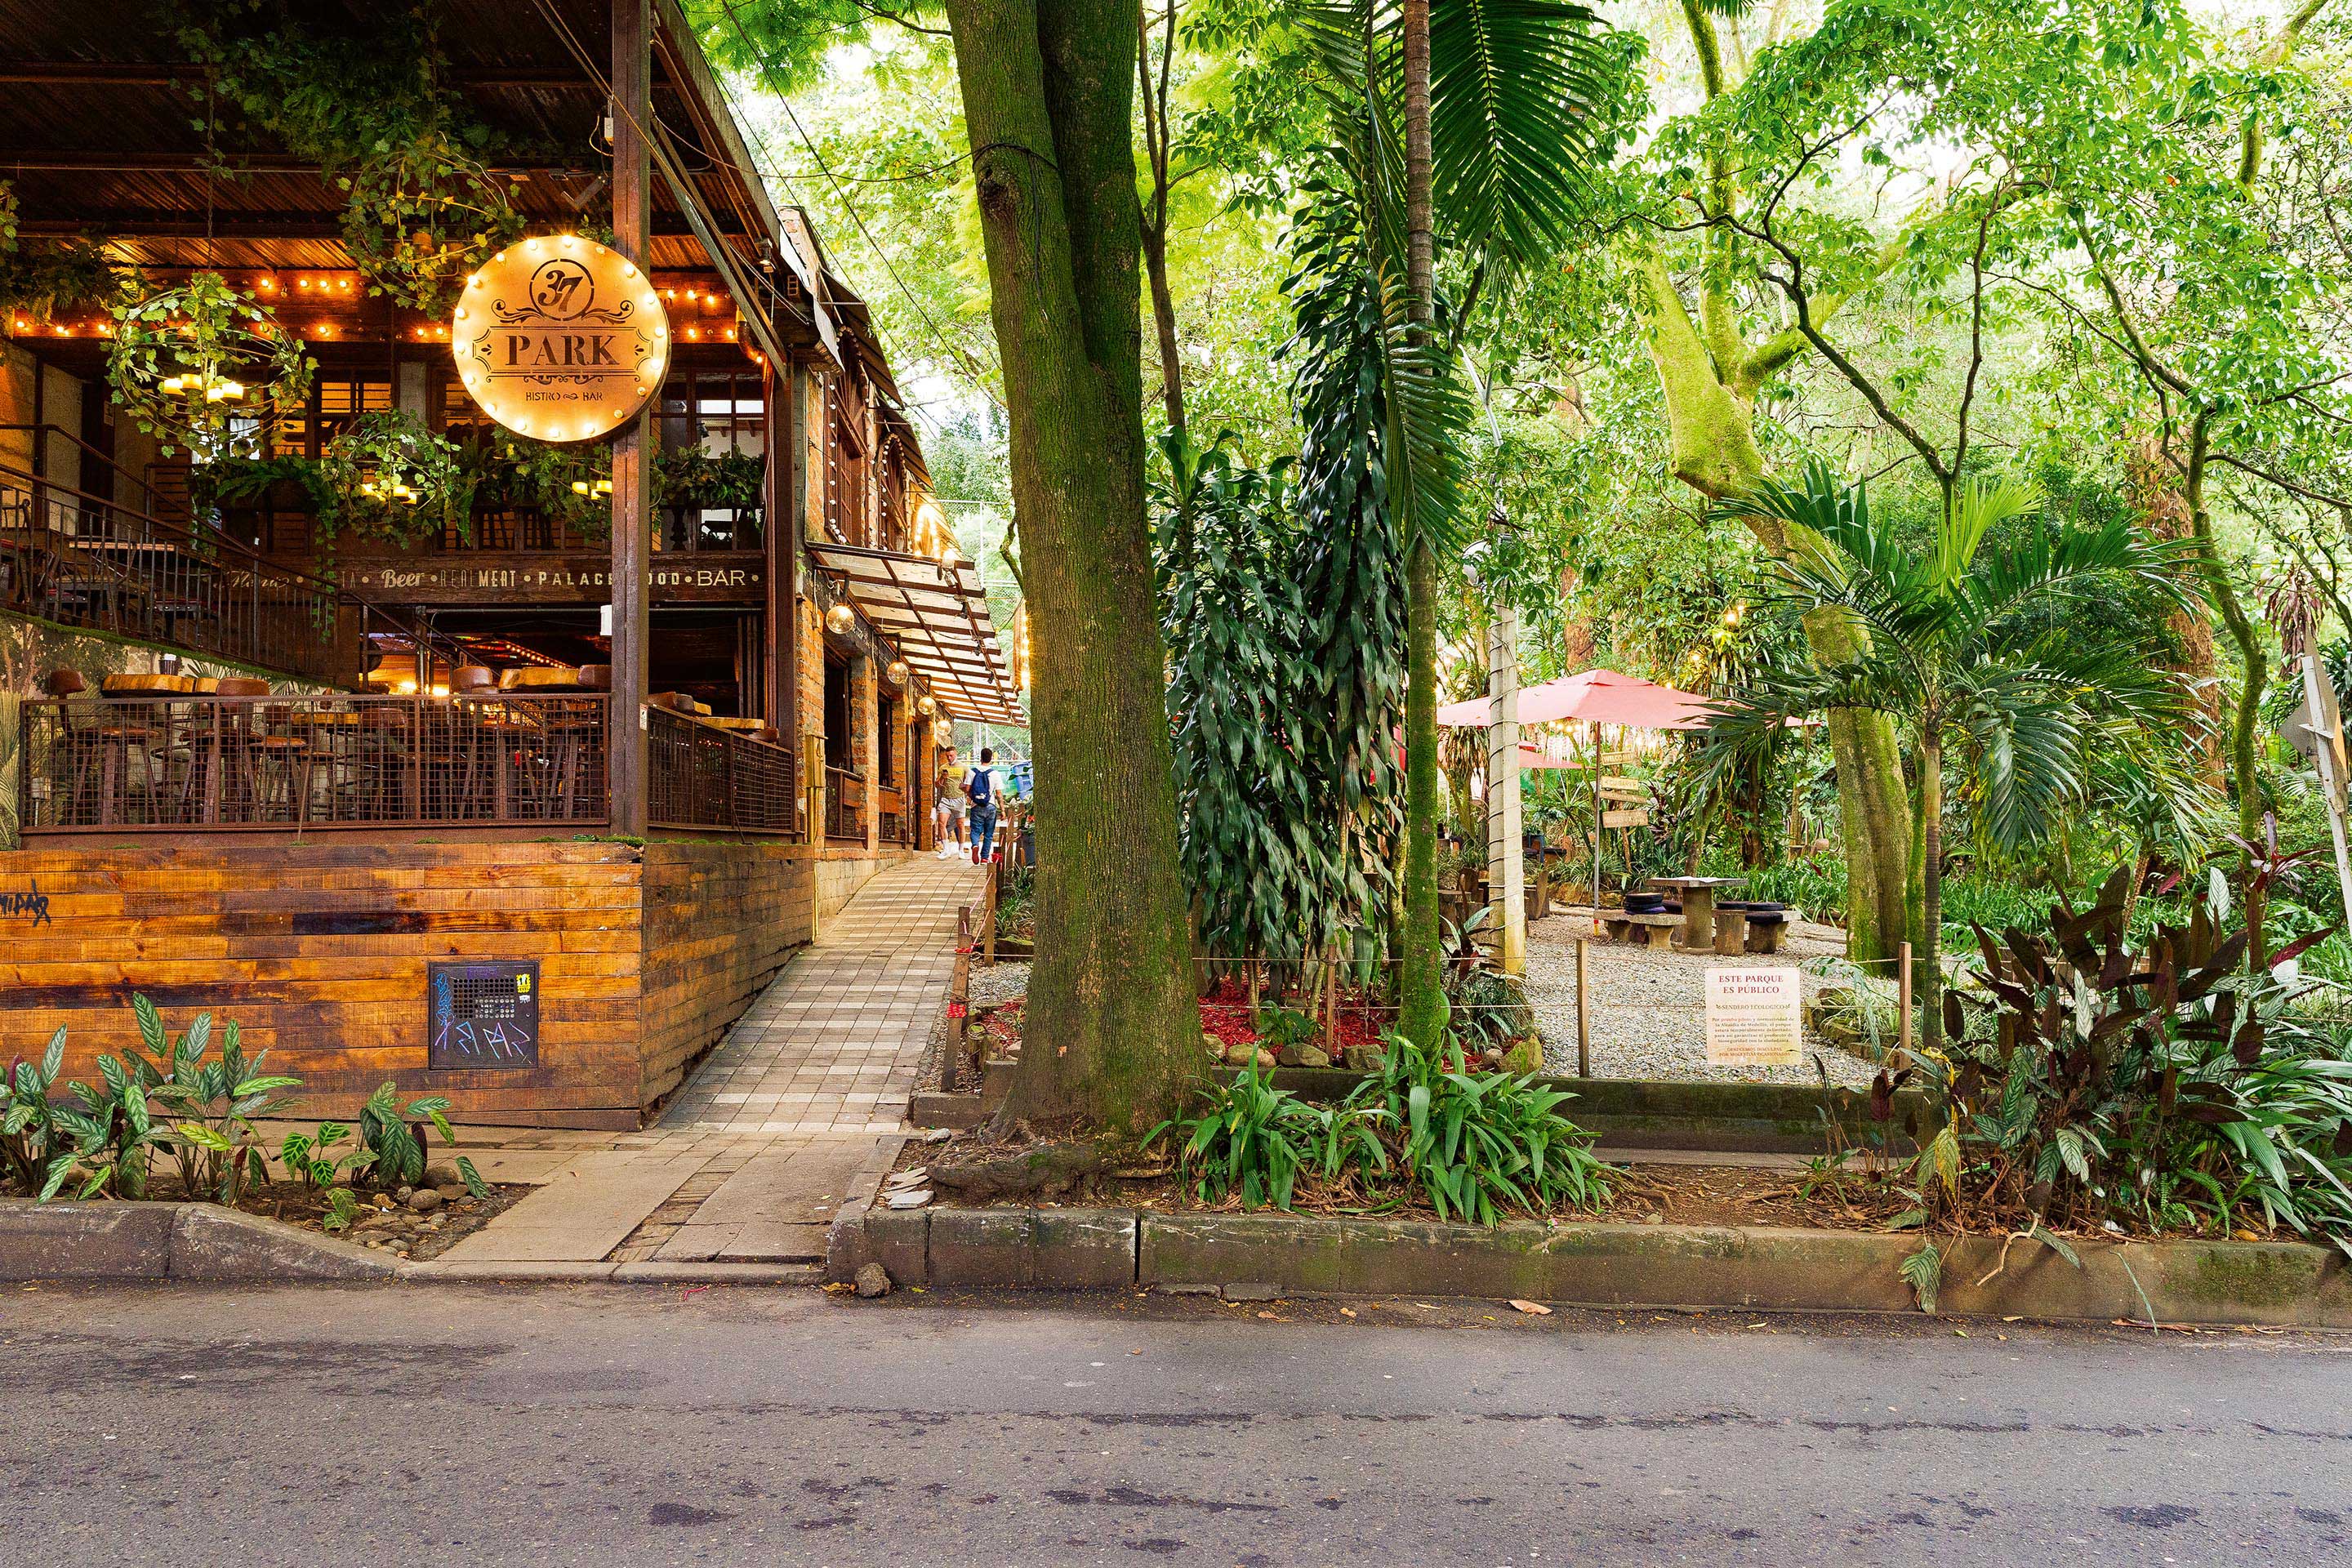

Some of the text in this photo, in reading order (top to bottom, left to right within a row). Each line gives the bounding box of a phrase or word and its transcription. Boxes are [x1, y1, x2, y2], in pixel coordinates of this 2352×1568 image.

[538, 270, 583, 312] 37
[506, 335, 620, 366] PARK
[526, 391, 603, 401] BISTRO BAR
[381, 569, 425, 588] Beer
[697, 570, 746, 586] BAR
[1738, 985, 1780, 993] PÚBLICO
